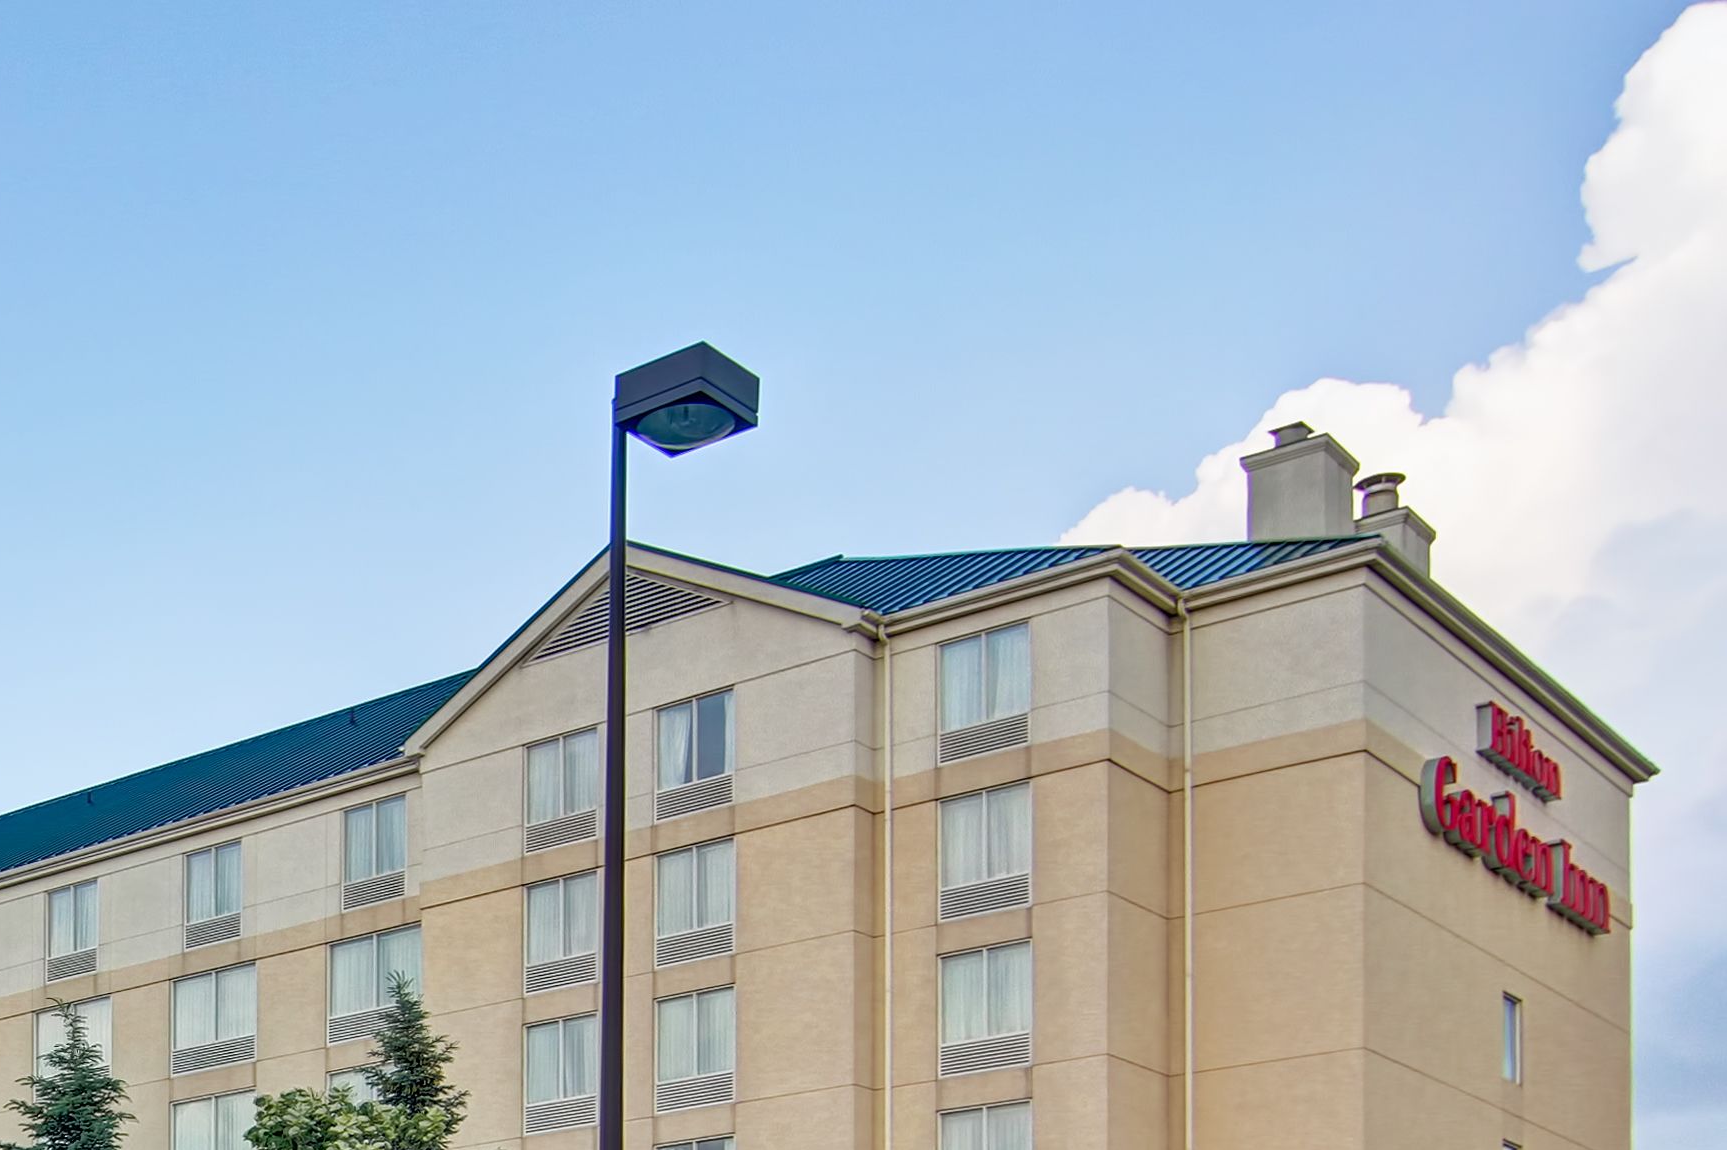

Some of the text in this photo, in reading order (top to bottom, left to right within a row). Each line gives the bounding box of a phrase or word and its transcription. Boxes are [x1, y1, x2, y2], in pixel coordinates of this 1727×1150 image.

[1486, 700, 1562, 801] Hilton
[1431, 756, 1611, 934] Garden Inn
